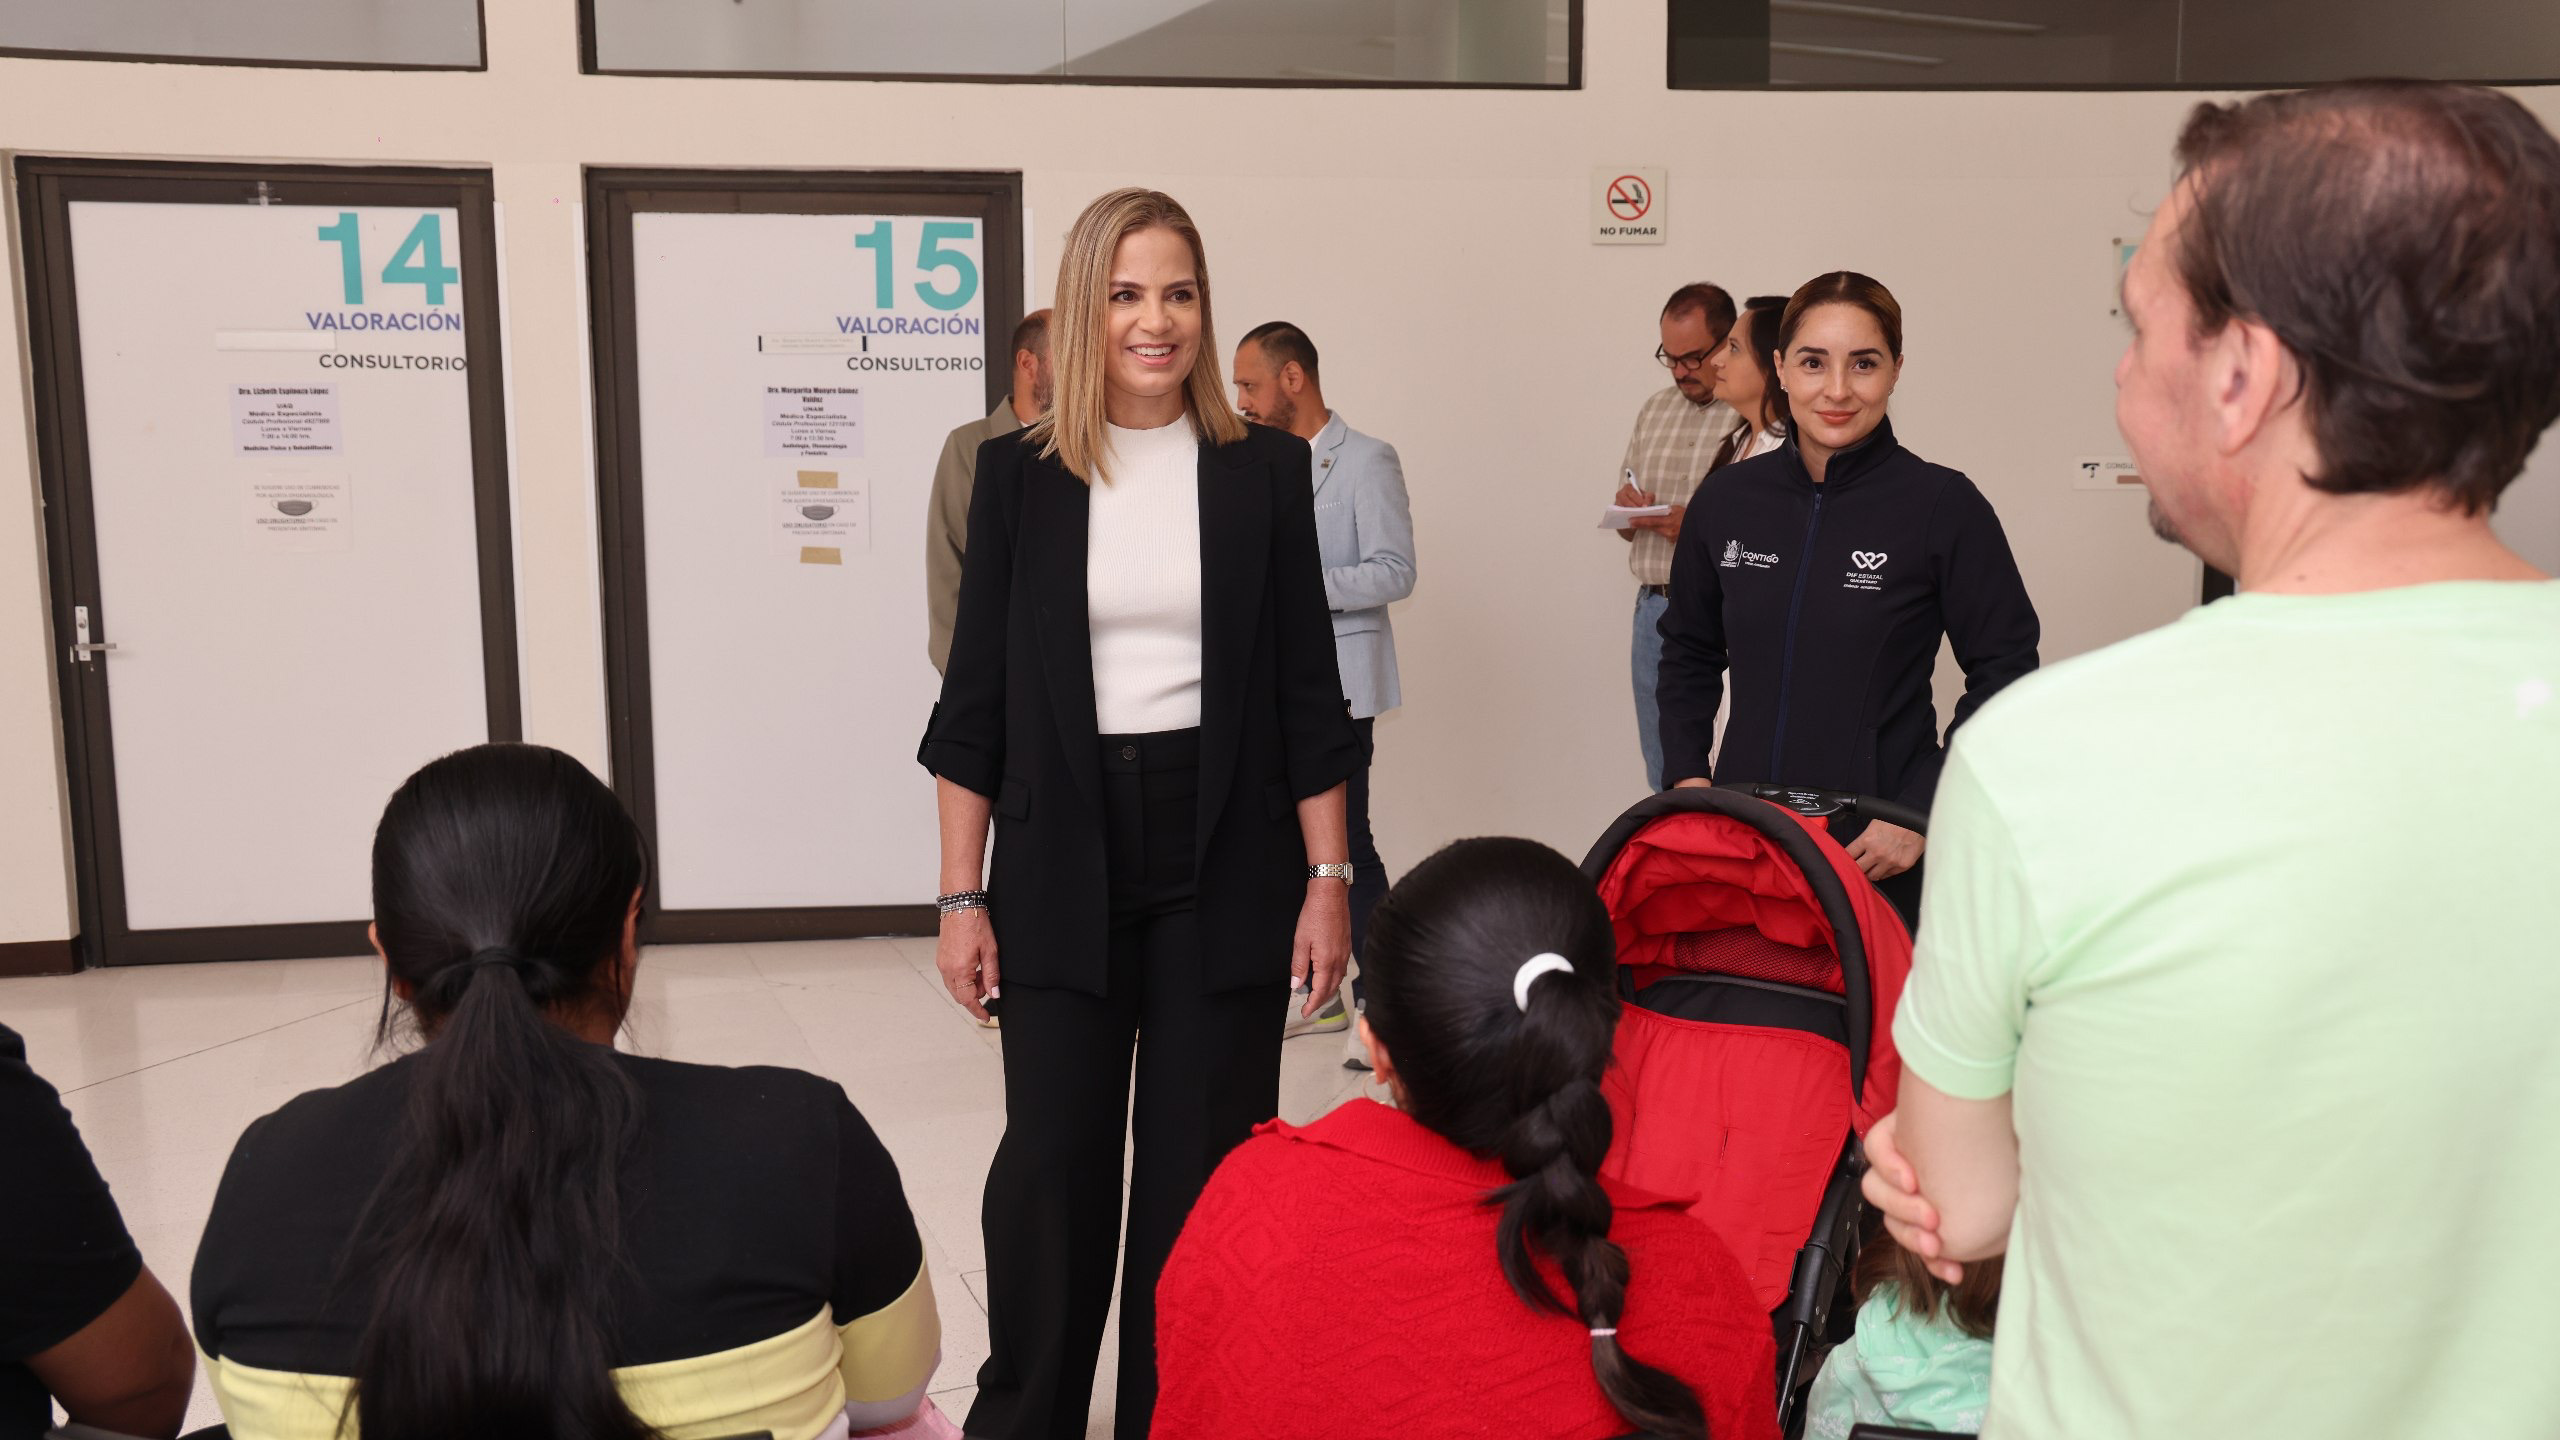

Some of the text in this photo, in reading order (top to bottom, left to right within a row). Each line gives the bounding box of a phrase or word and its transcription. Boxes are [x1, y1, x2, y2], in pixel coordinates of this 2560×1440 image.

[1600, 227, 1657, 235] NO FUMAR
[318, 212, 458, 304] 14
[855, 221, 978, 310] 15
[306, 308, 461, 331] VALORACIÓN
[837, 314, 979, 334] VALORACIÓN
[319, 354, 467, 371] CONSULTORIO
[847, 357, 983, 371] CONSULTORIO
[1742, 551, 1779, 564] CONTIGO
